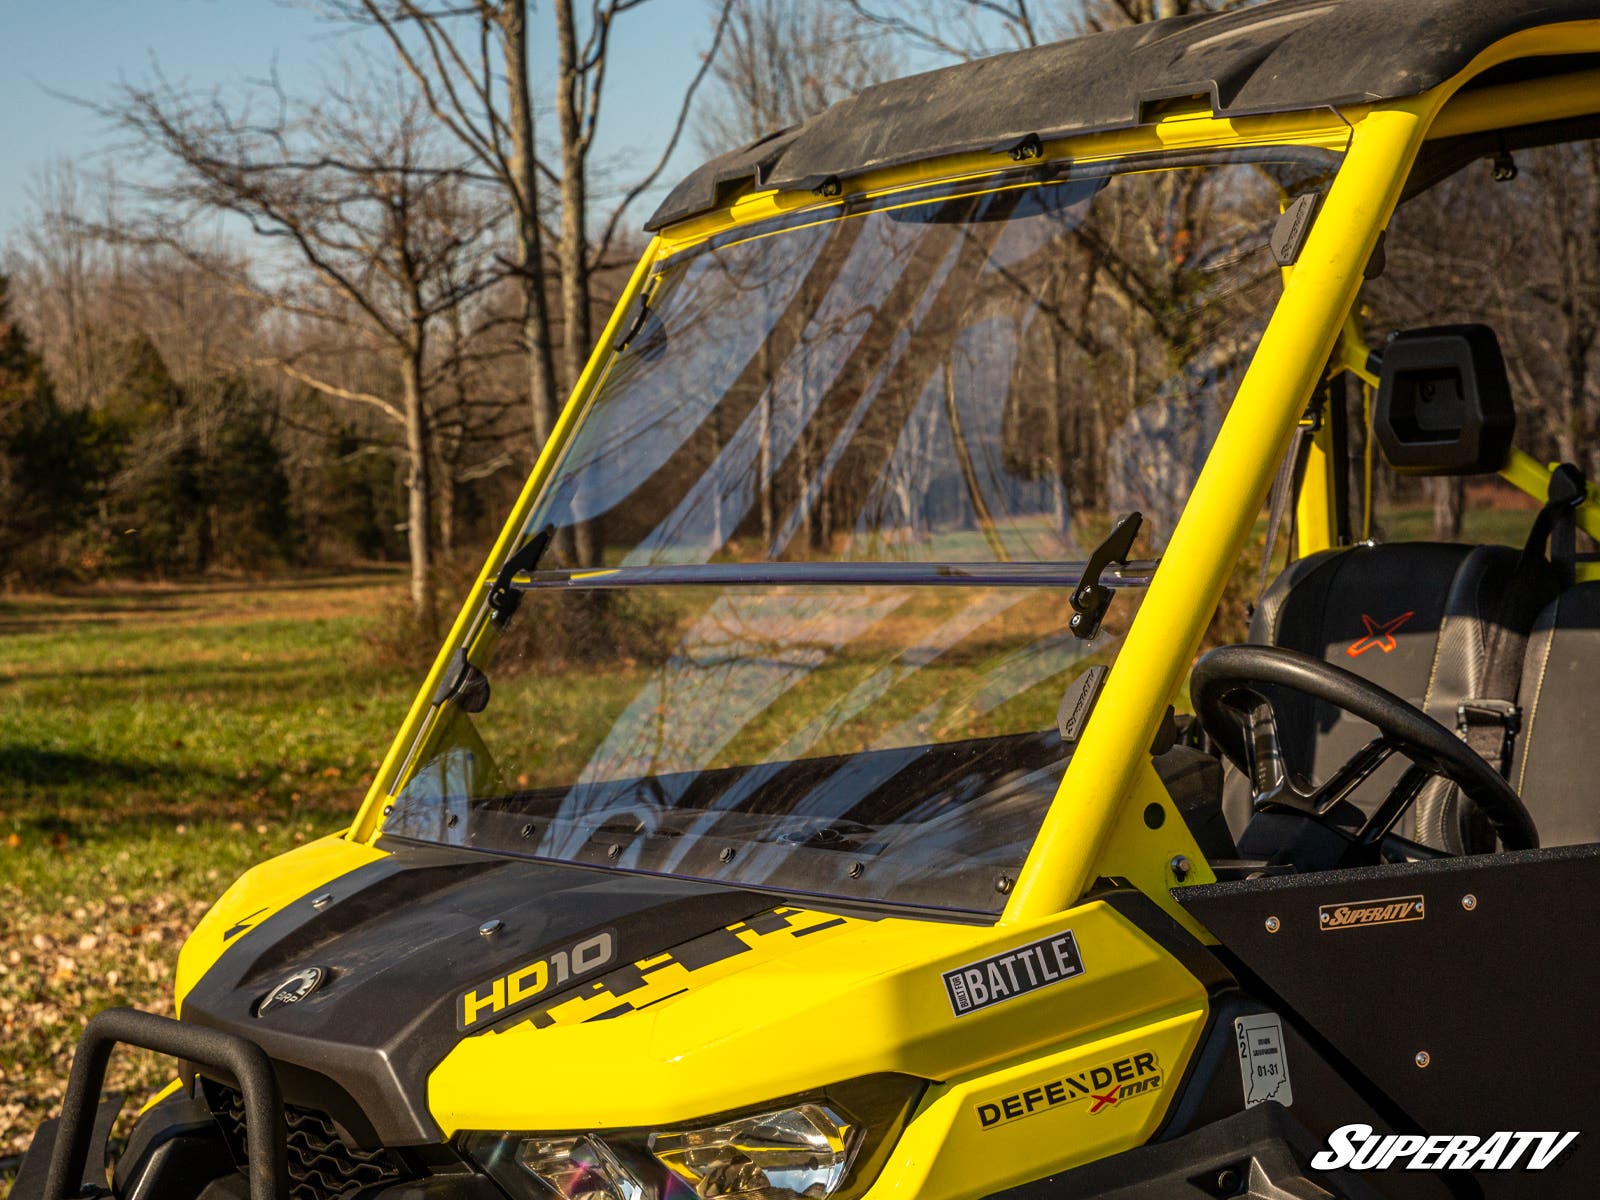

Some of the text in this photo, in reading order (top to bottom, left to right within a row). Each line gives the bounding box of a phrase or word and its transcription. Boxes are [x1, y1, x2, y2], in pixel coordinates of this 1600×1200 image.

[1329, 902, 1415, 925] SUPERATV
[464, 932, 612, 1026] HD10
[952, 976, 962, 991] FOR
[964, 938, 1076, 1006] BATTLE
[977, 1052, 1157, 1127] DEFENDER
[1257, 1063, 1279, 1077] 01-31
